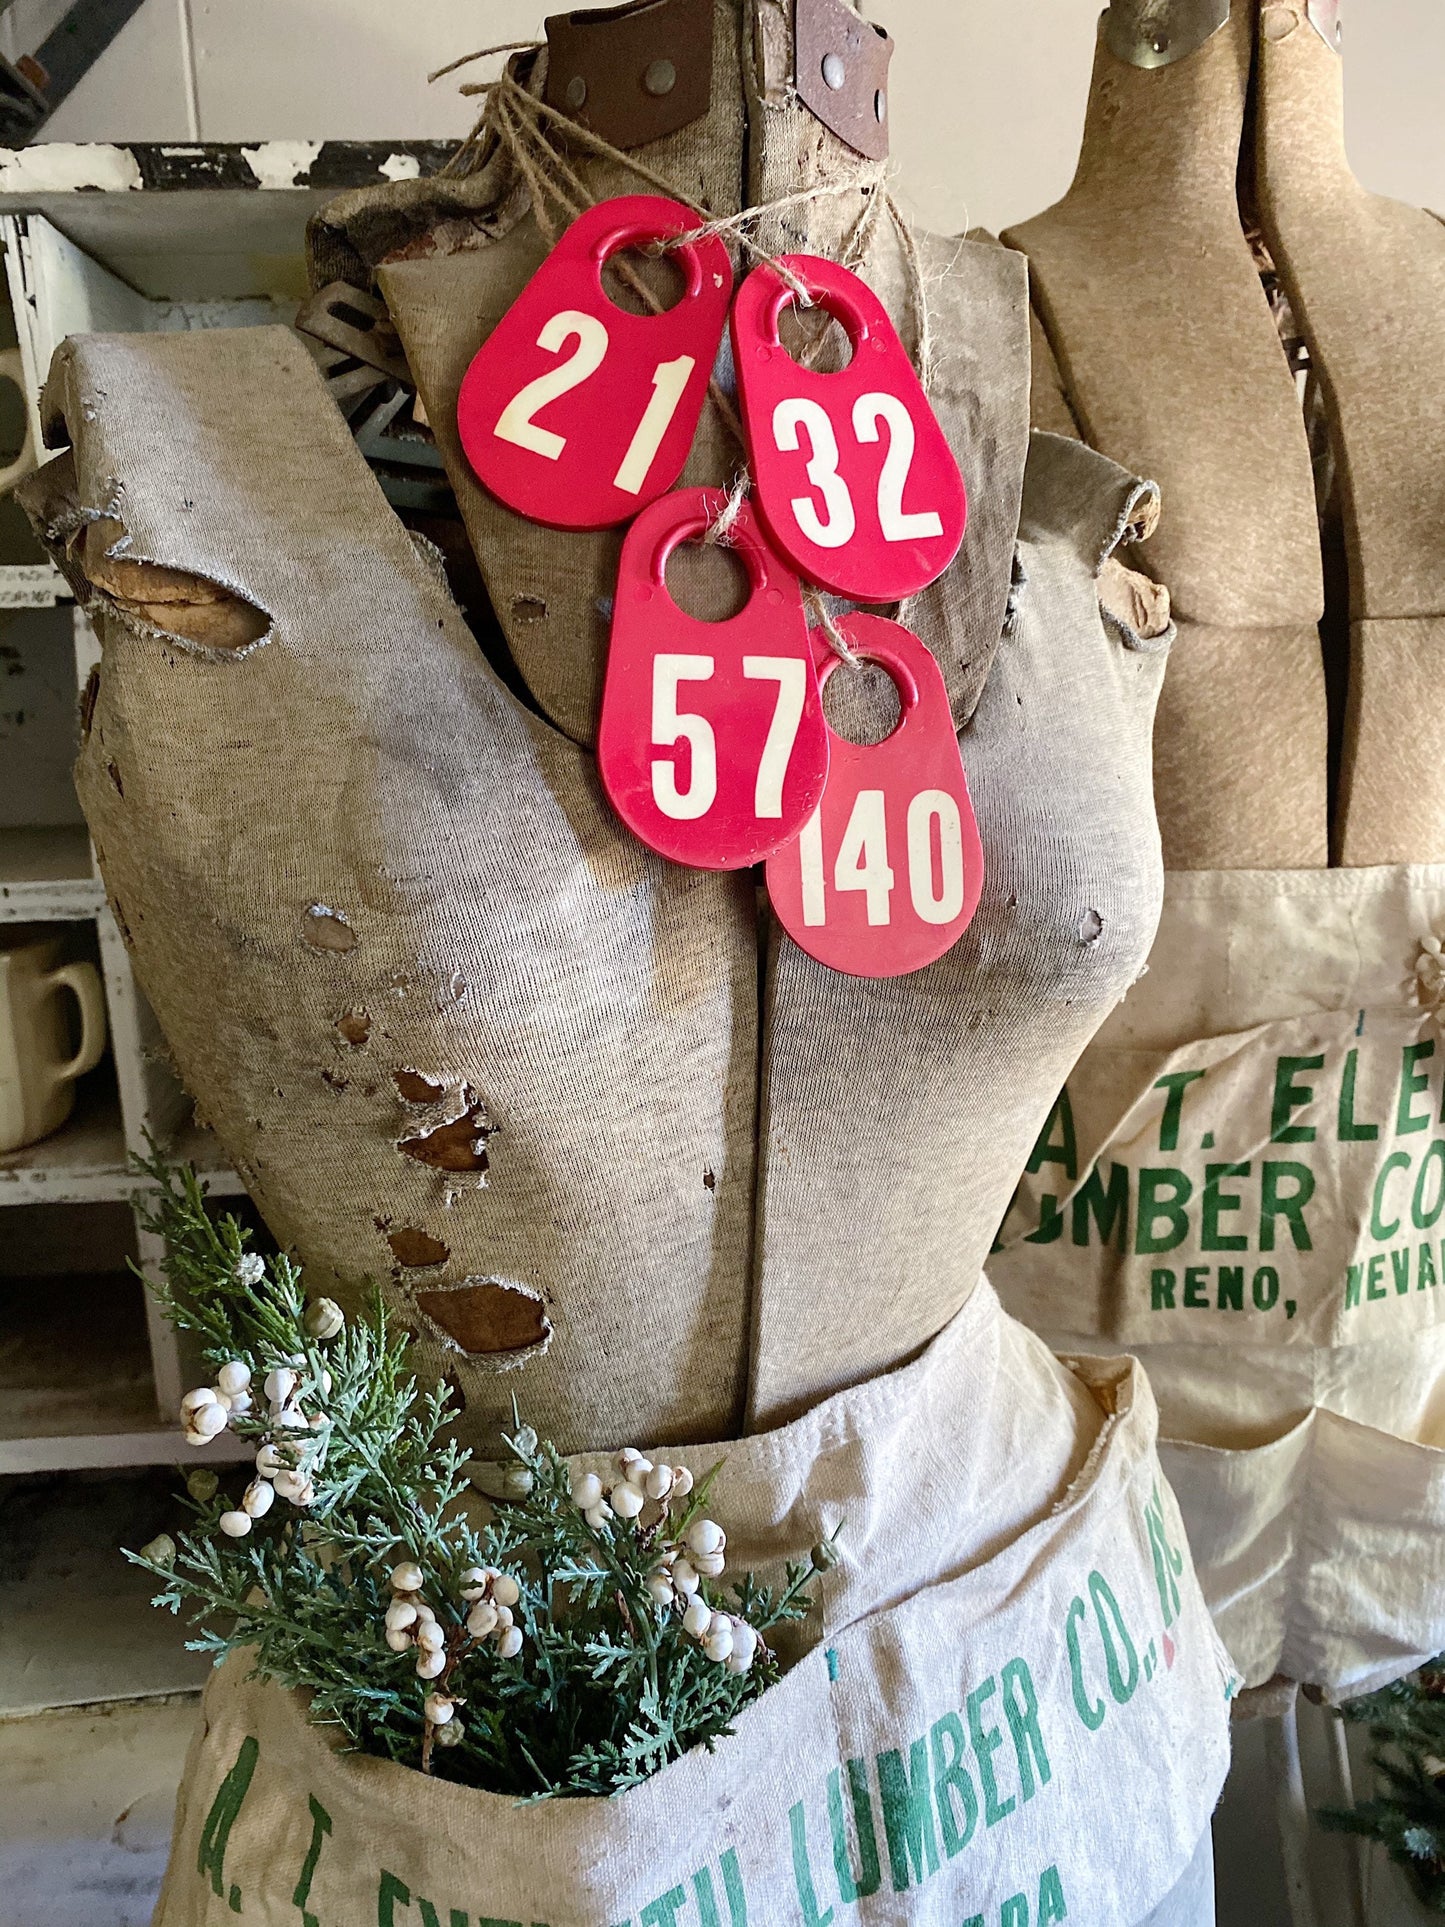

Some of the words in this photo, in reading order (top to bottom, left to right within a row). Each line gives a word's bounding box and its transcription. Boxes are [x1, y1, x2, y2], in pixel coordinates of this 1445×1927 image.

[494, 310, 695, 495] 21
[771, 392, 944, 549] 32
[650, 653, 808, 820] 57
[799, 789, 965, 927] 140
[1270, 1039, 1445, 1142] ELE
[991, 1160, 1315, 1255] UMBER
[1150, 1265, 1297, 1319] RENO,
[1344, 1238, 1445, 1311] NEVA
[788, 1656, 1052, 1926] LUMBER
